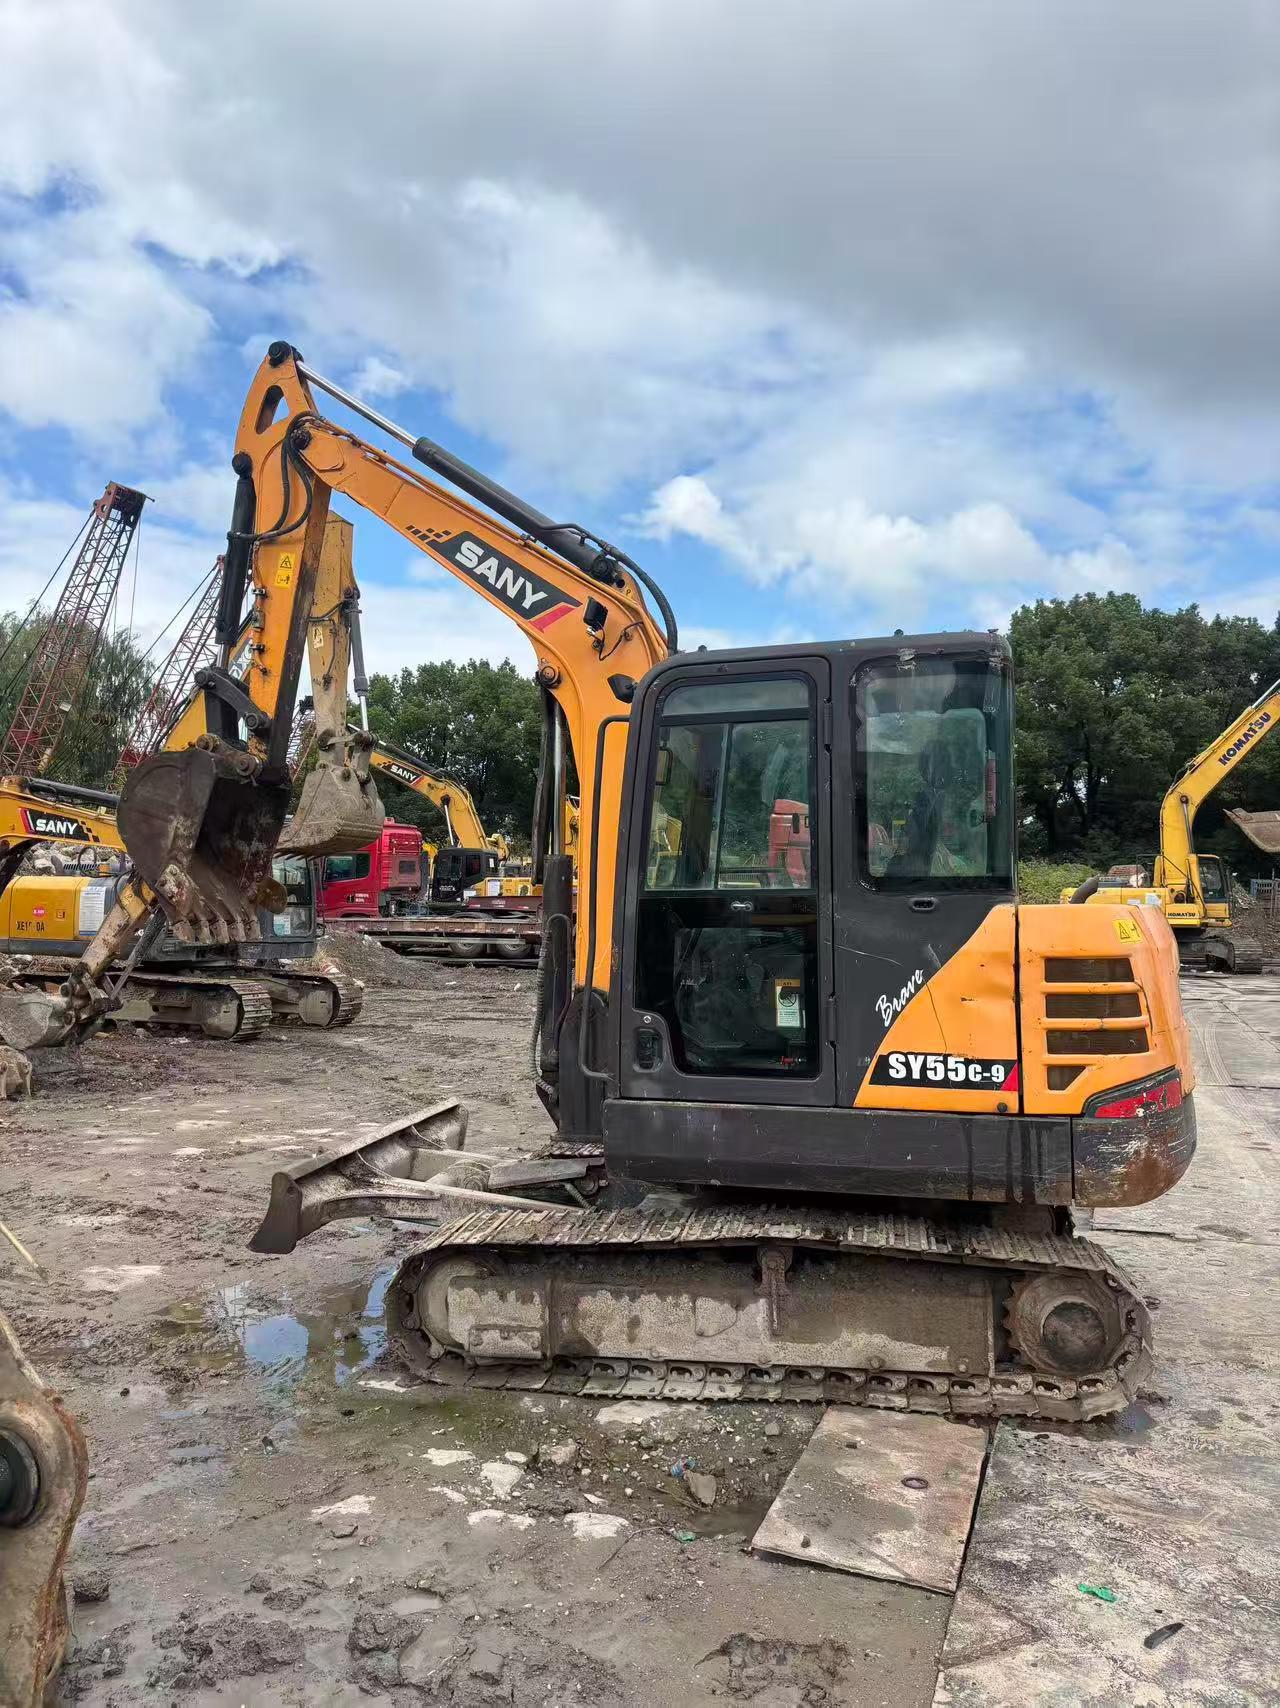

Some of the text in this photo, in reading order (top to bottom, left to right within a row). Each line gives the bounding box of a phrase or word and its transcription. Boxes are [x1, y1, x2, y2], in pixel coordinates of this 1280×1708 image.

[455, 541, 548, 609] SANY
[1218, 712, 1271, 766] KOMATSU
[390, 764, 417, 781] SANY
[36, 819, 78, 835] SANY
[875, 969, 924, 1027] Brave
